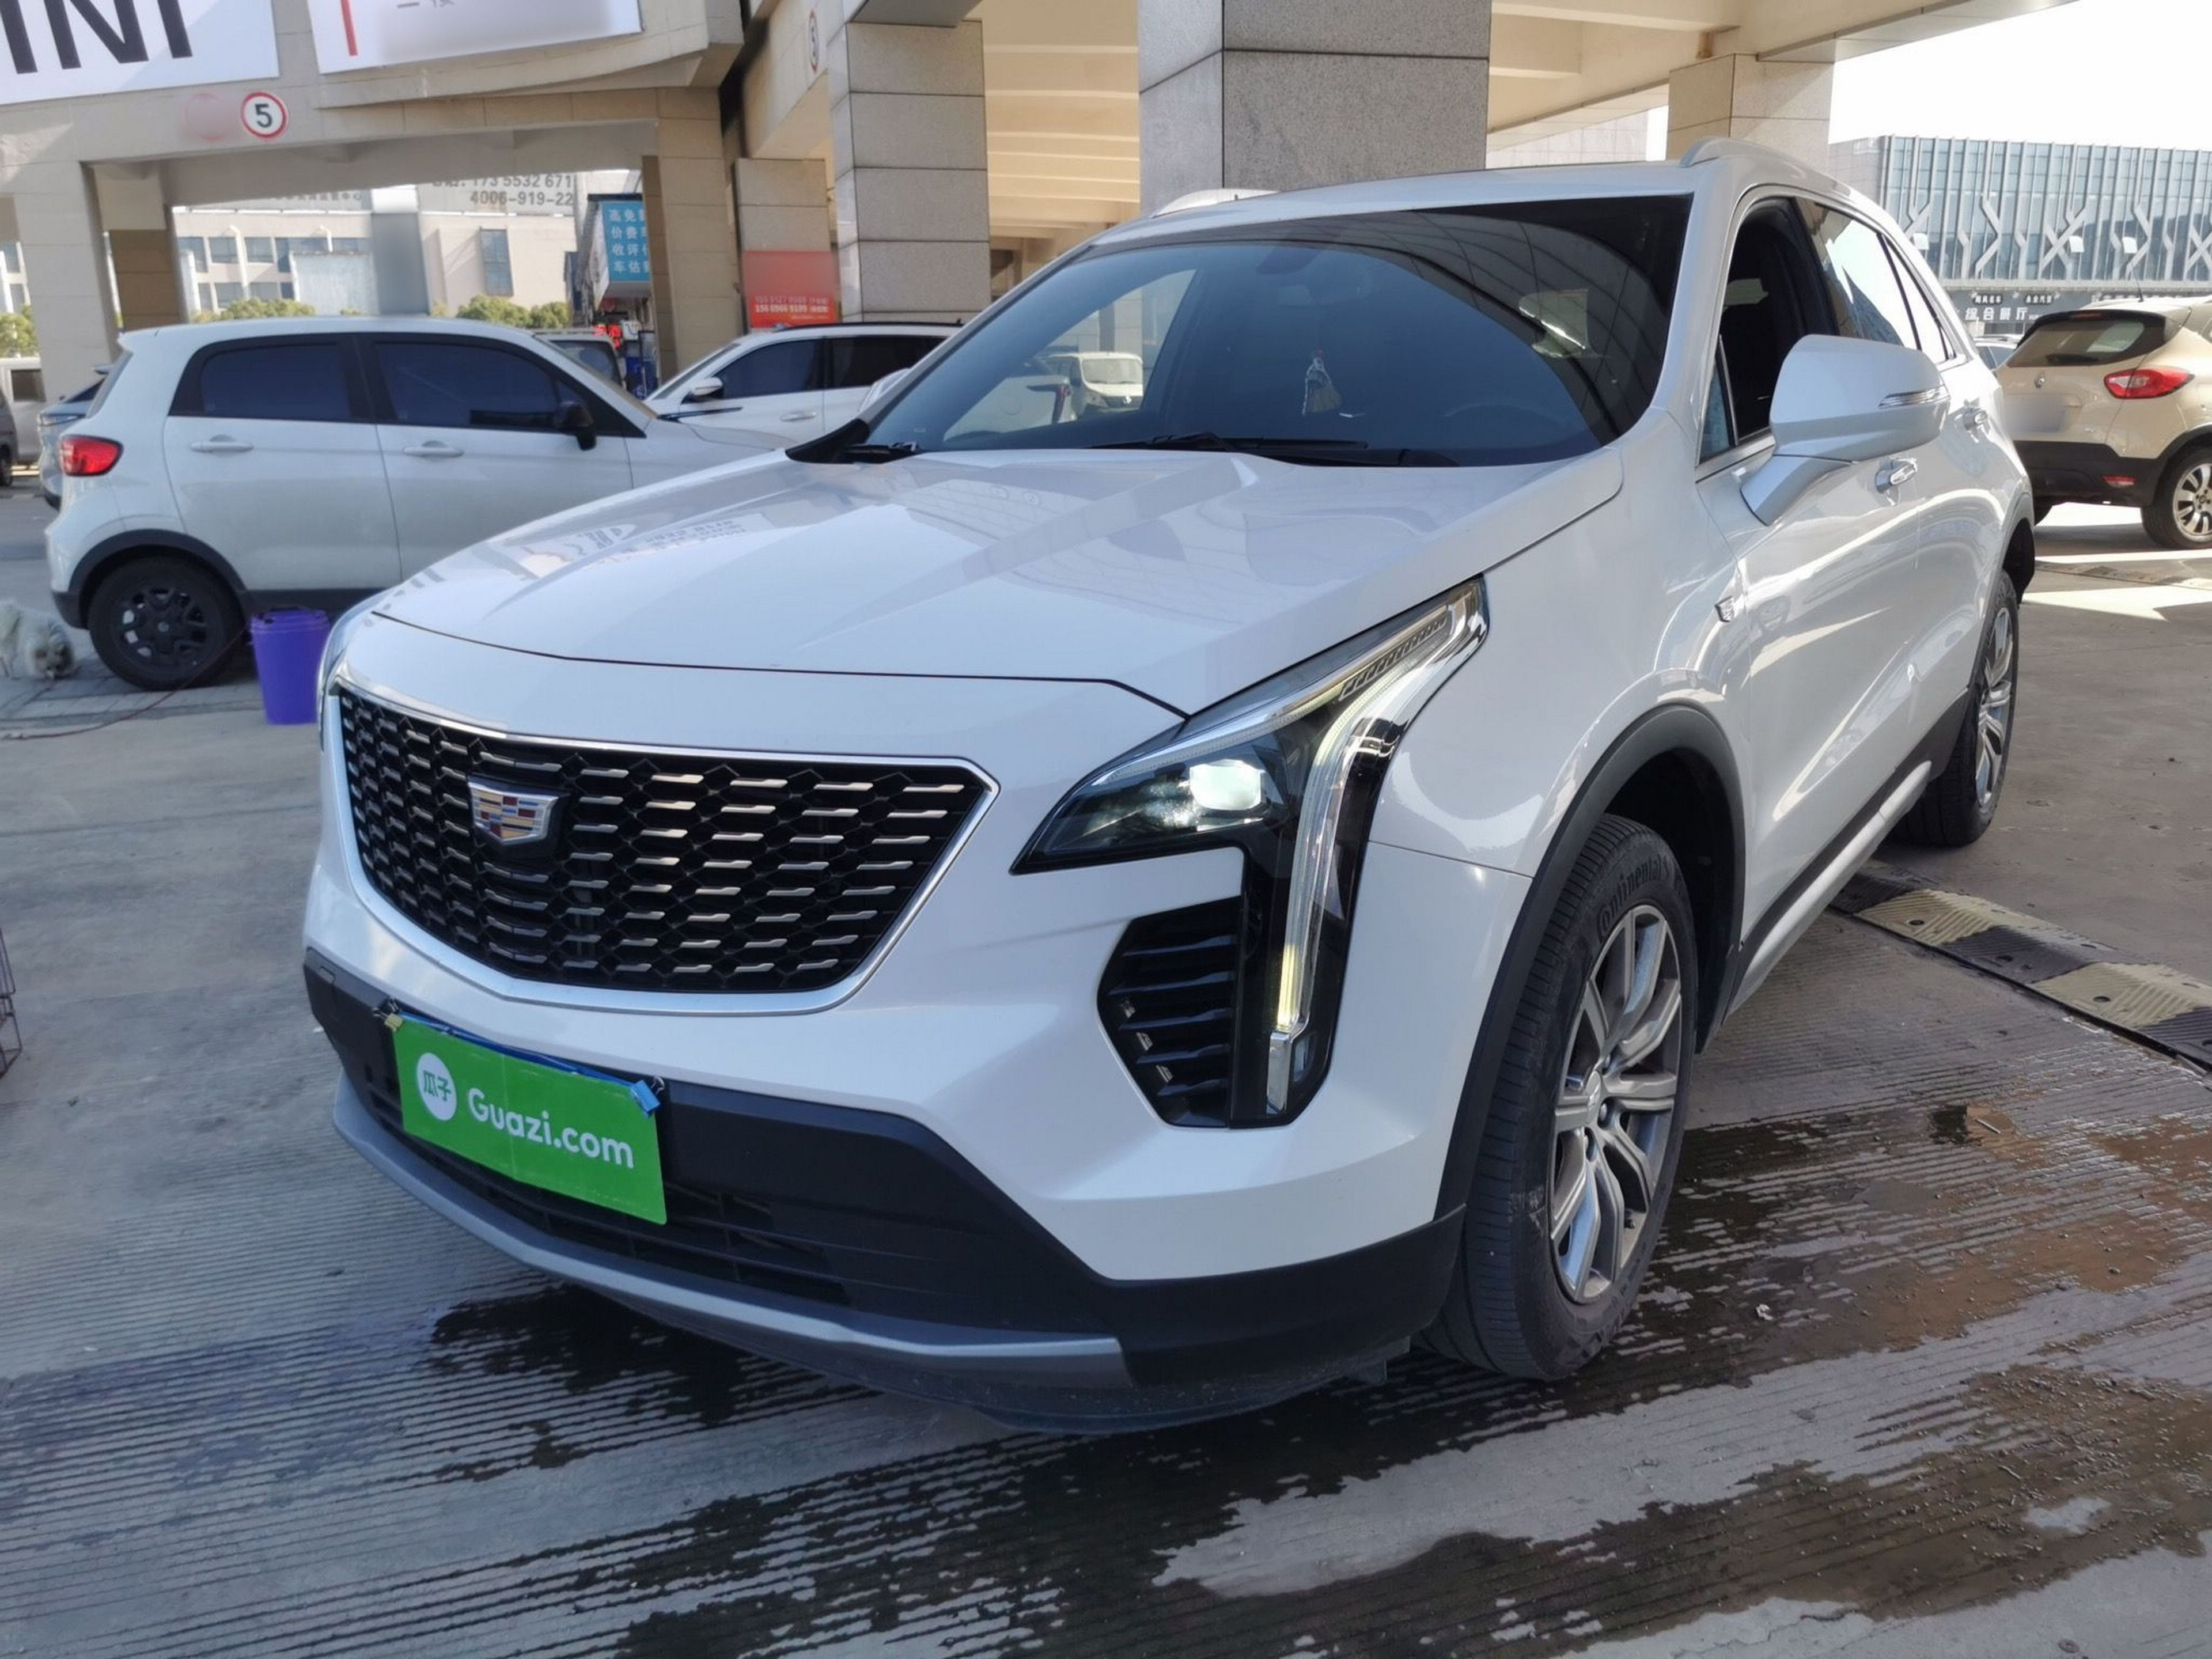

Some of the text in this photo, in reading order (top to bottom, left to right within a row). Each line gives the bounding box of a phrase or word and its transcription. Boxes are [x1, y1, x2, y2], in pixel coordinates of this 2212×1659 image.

[254, 103, 273, 128] 5
[422, 1069, 452, 1102] 瓜子
[467, 1088, 634, 1169] Guazi.com
